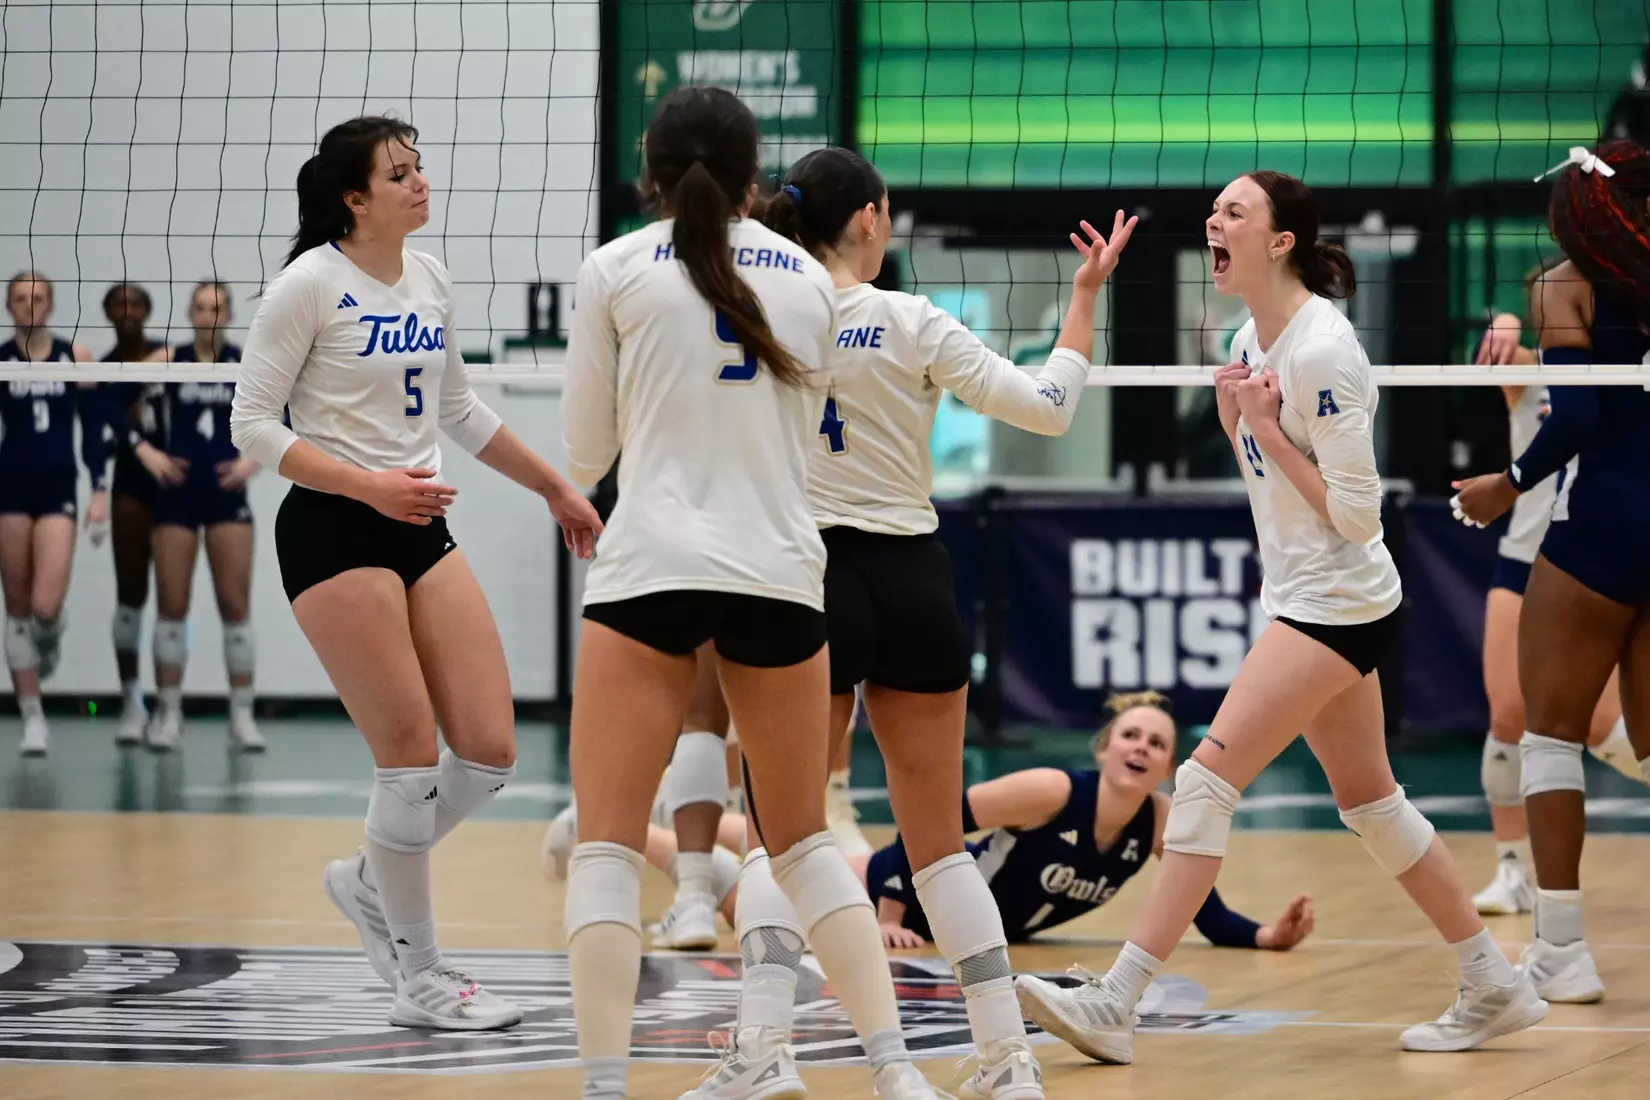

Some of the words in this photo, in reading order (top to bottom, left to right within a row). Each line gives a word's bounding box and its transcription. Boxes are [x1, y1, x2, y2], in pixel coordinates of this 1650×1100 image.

[356, 312, 445, 357] Tulsa
[402, 365, 424, 418] 5
[1070, 538, 1251, 597] BUILT
